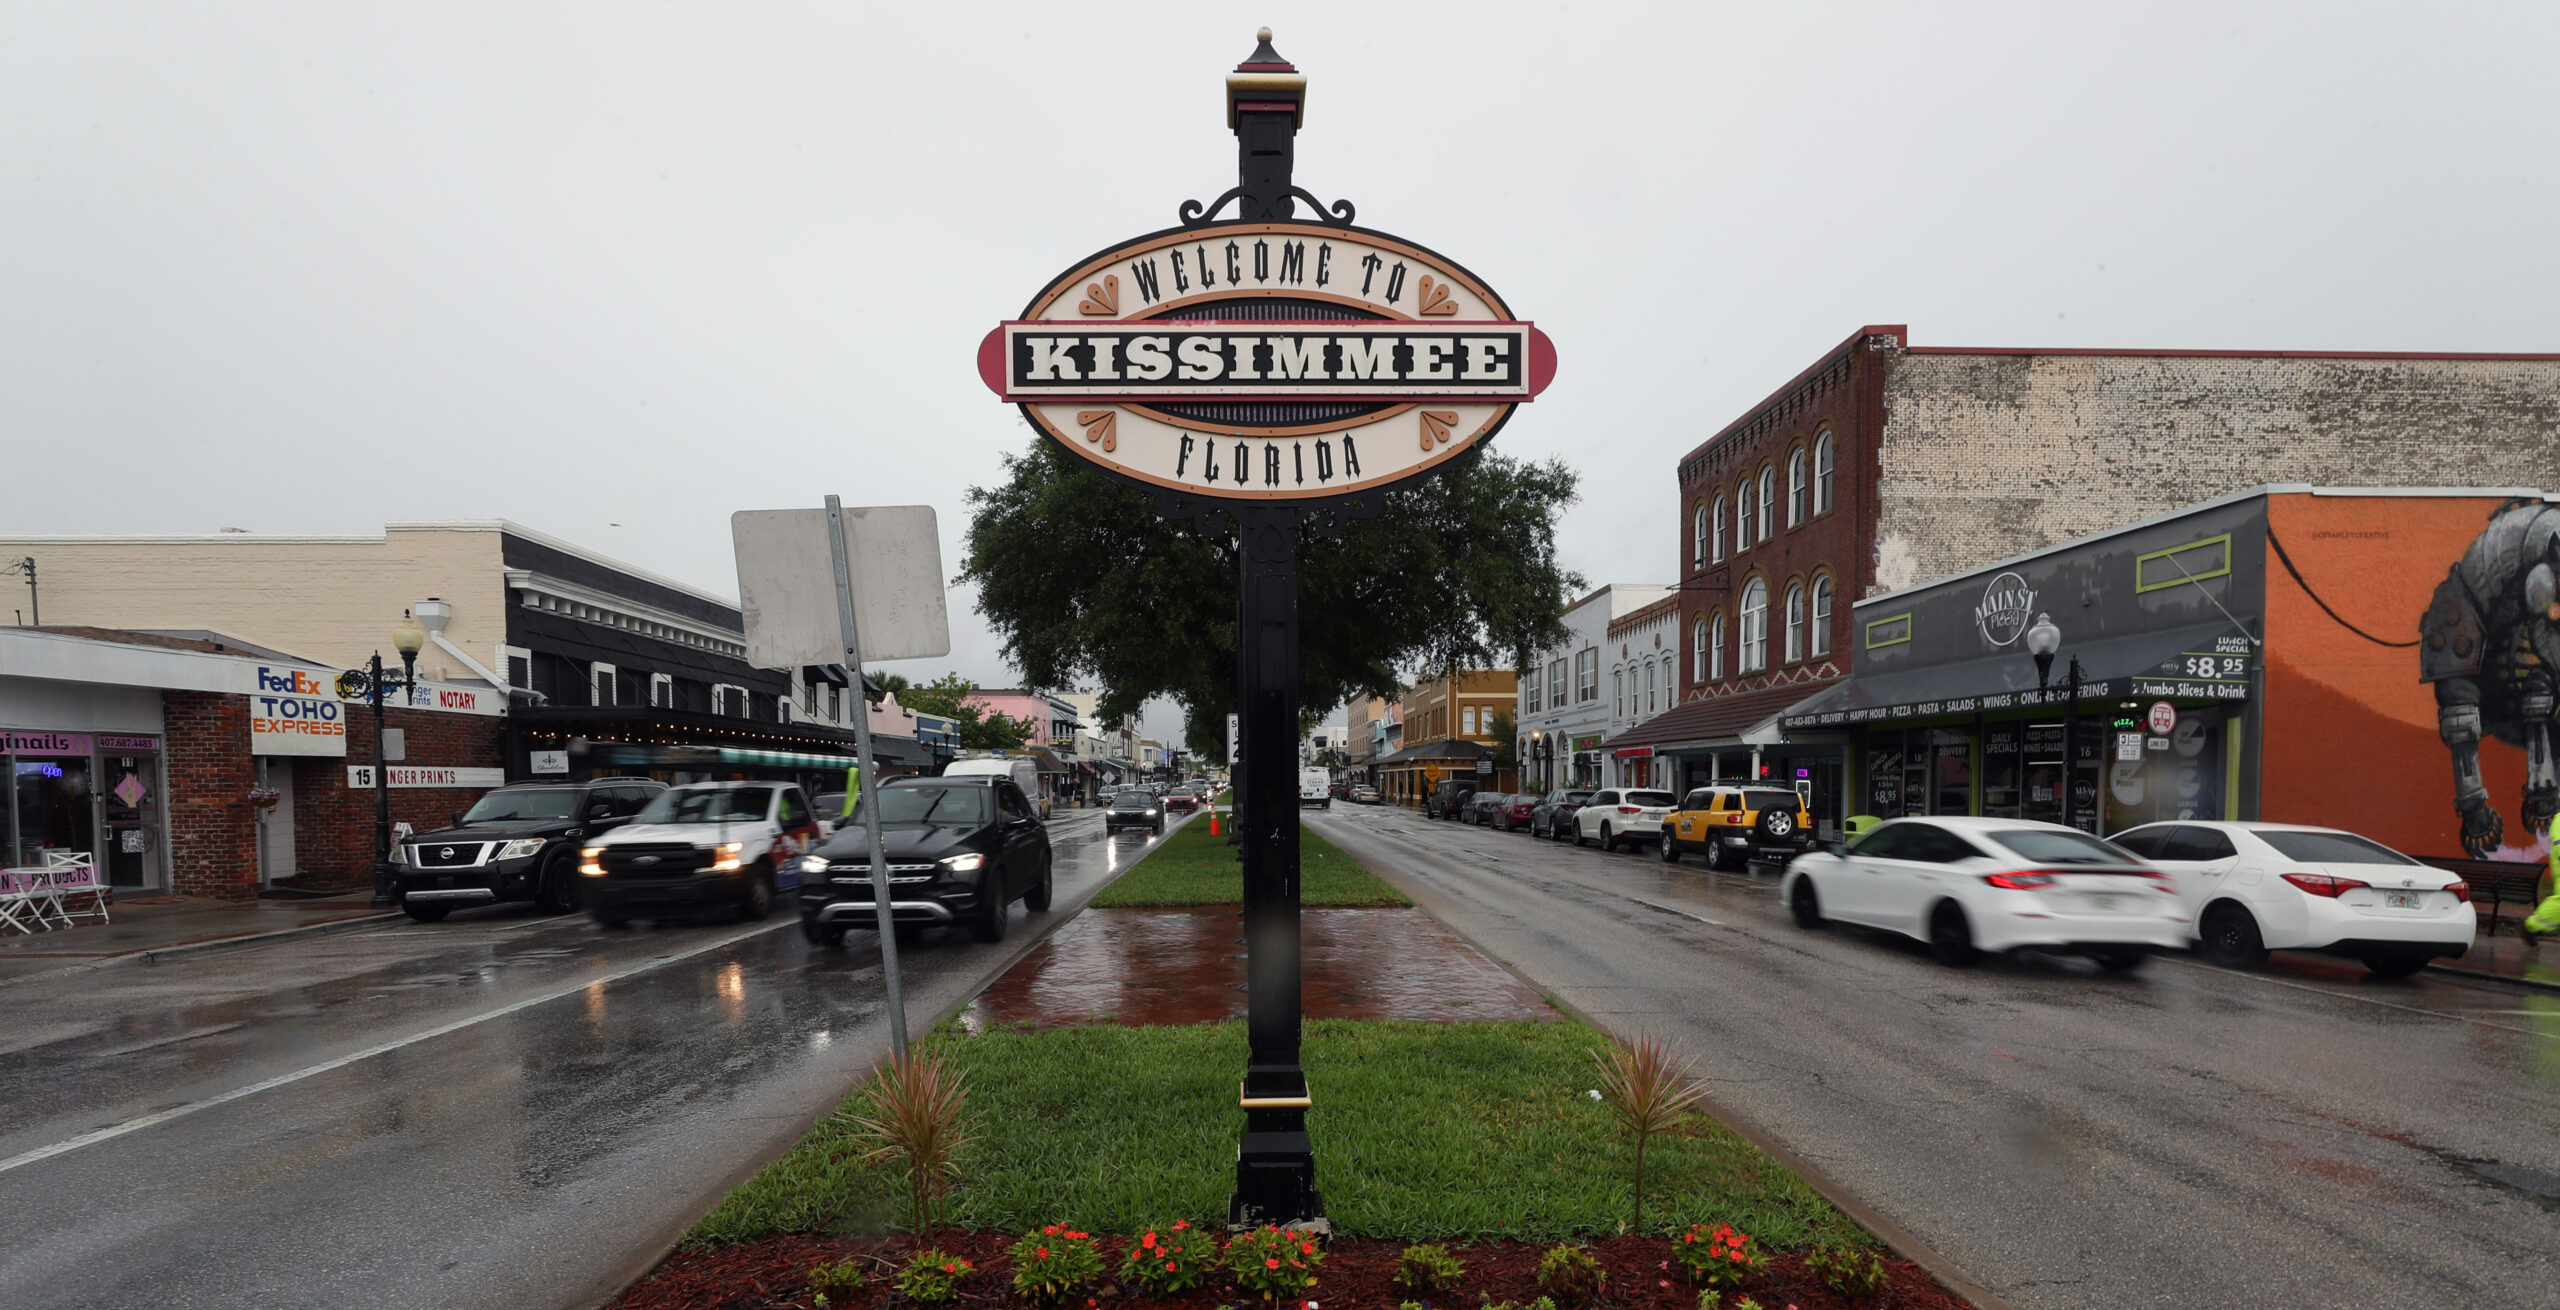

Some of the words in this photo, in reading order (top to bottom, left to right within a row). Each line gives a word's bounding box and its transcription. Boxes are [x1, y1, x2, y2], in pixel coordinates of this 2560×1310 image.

[1131, 237, 1332, 305] WELCOME
[1361, 251, 1407, 305] TO
[1026, 335, 1509, 381] KISSIMMEE
[1176, 432, 1361, 488] FLORIDA
[2218, 636, 2248, 645] LUNCH
[2215, 645, 2249, 653] SPECIAL
[2186, 656, 2244, 679] $8.95
[257, 666, 322, 696] FedEx
[2141, 682, 2175, 695] Jumbo
[2177, 682, 2204, 697] Slices
[2207, 684, 2215, 697] &
[2217, 684, 2246, 698] Drink
[412, 694, 431, 706] rints
[440, 690, 476, 710] NOTARY
[260, 697, 337, 721] TOHO
[1821, 712, 1844, 723] DELIVERY
[1850, 710, 1868, 721] HAPPY
[1869, 708, 1887, 719] HOUR
[1892, 705, 1911, 717] PIZZA
[1918, 703, 1939, 715] PASTA
[1946, 699, 1975, 712] SALADS
[1983, 694, 2011, 709] WINGS
[252, 718, 345, 736] EXPRESS
[2113, 718, 2134, 728] PIZZA
[1992, 733, 2012, 743] DAILY
[1938, 746, 1967, 756] DELIVERY
[1986, 742, 2018, 754] SPECIALS
[2081, 747, 2091, 757] 16
[355, 769, 371, 786] 15
[385, 769, 417, 785] INGER
[420, 770, 456, 785] PRINTS
[1874, 790, 1897, 804] $8.95
